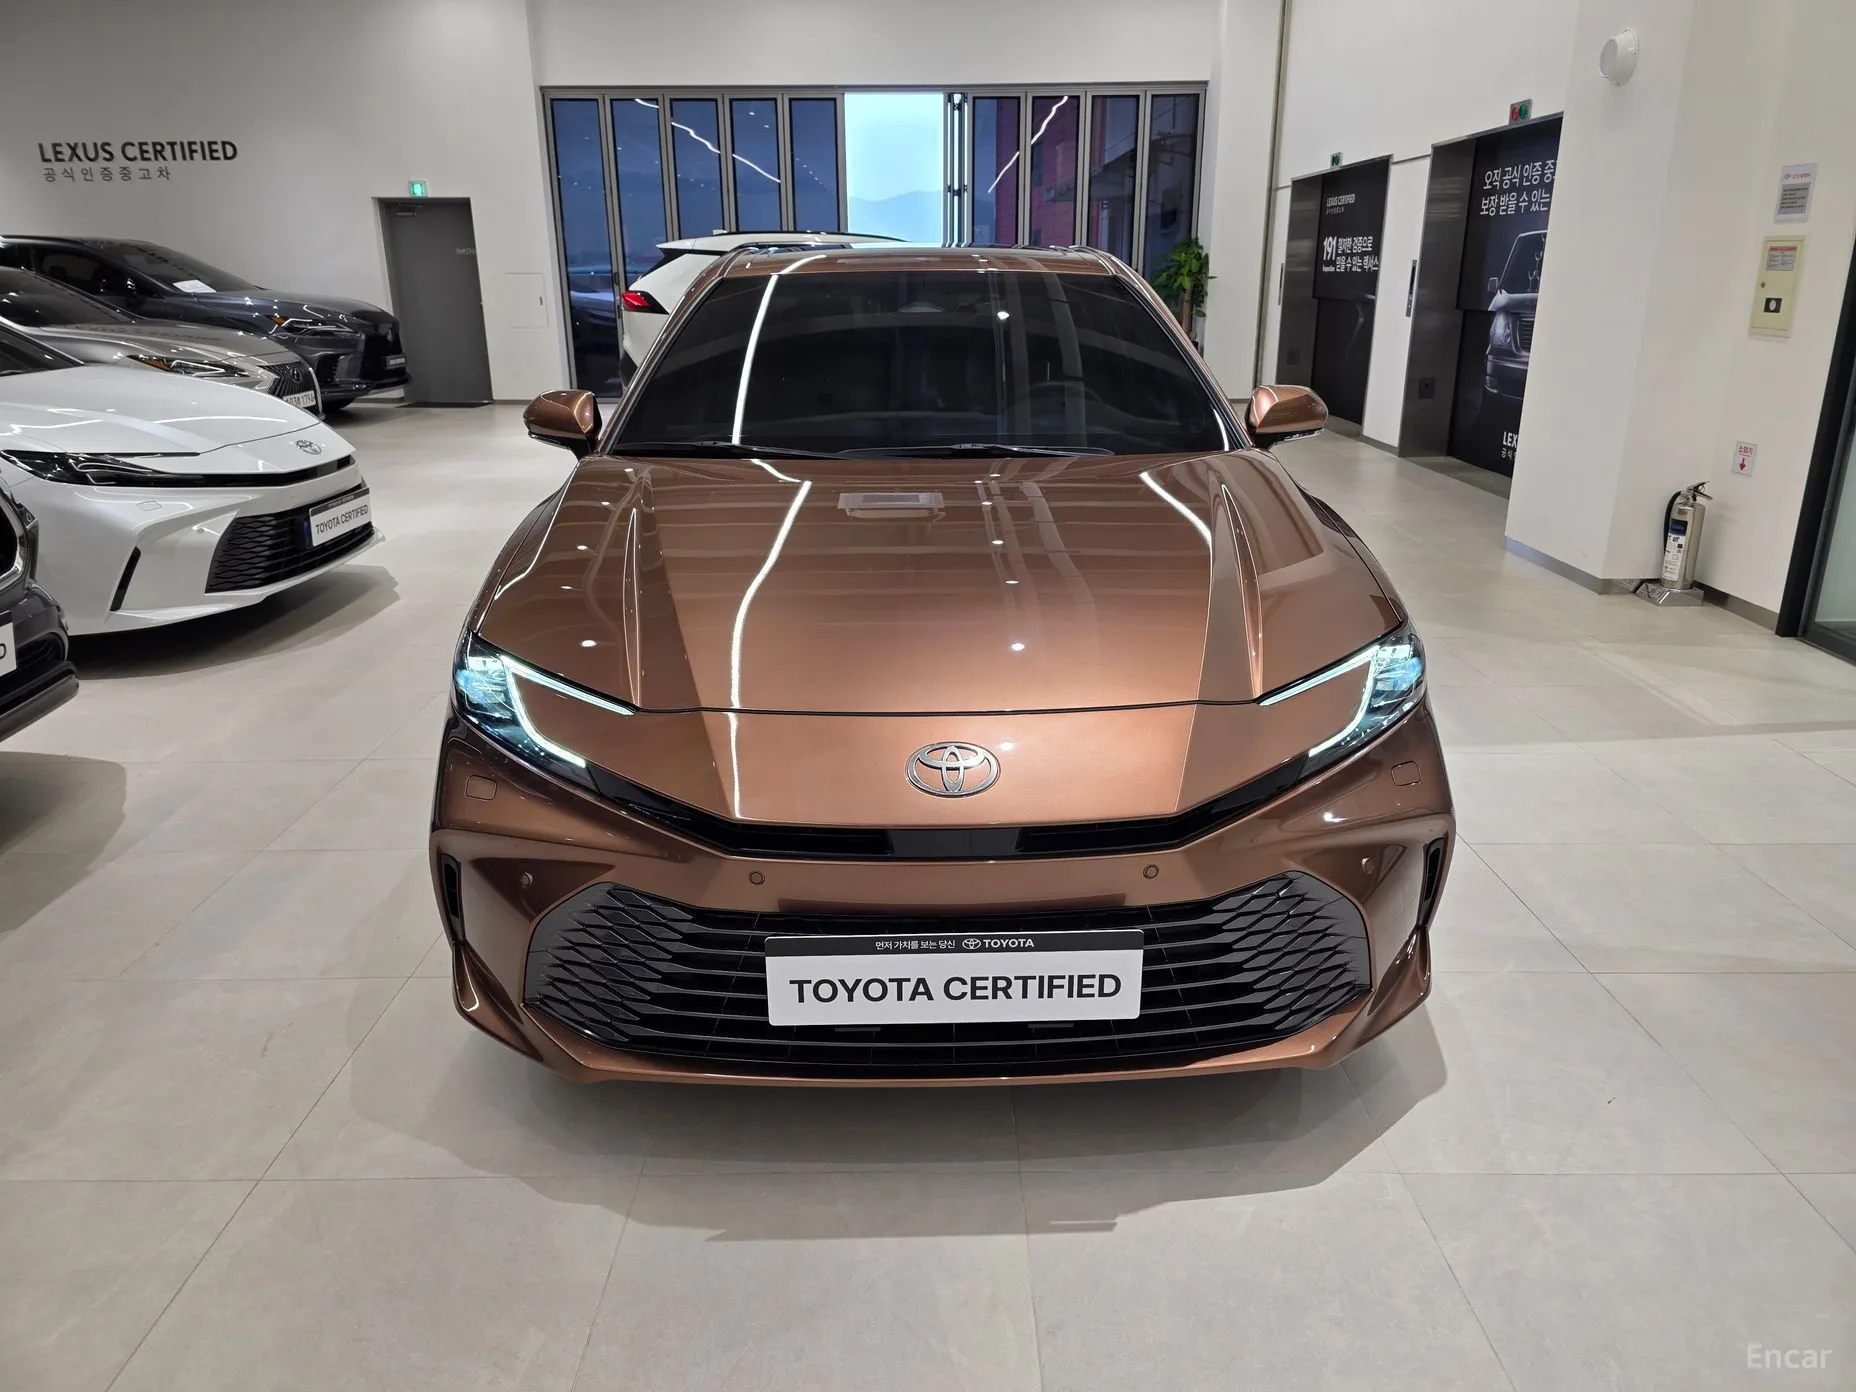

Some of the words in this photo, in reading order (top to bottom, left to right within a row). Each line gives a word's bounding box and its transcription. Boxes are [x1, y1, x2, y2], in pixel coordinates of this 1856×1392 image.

[38, 142, 115, 163] LEXUS
[120, 141, 238, 162] CERTIFIED
[43, 166, 171, 183] 공식인증중고차
[1483, 168, 1501, 190] 오직
[1502, 164, 1521, 189] 공식
[1523, 162, 1542, 186] 인증
[1544, 160, 1556, 183] 중
[1480, 194, 1498, 216] 보장
[1500, 192, 1517, 215] 받을
[1519, 191, 1529, 213] 수
[1530, 188, 1550, 211] 있는
[1323, 236, 1337, 260] 191
[1352, 236, 1373, 253] 검증으로
[1346, 256, 1352, 272] 수
[1352, 256, 1363, 272] 있는
[1363, 255, 1379, 273] 렉서스
[1501, 447, 1516, 460] 공식
[315, 516, 340, 535] TOYOTA
[340, 504, 369, 524] CERTIFIED
[875, 941, 892, 950] 먼저
[894, 940, 919, 950] 가치를
[920, 940, 937, 949] 보는
[939, 940, 955, 949] 당신
[983, 938, 1034, 948] TOYOTA
[789, 977, 934, 1003] TOYOTA
[943, 974, 1122, 1001] CERTIFIED
